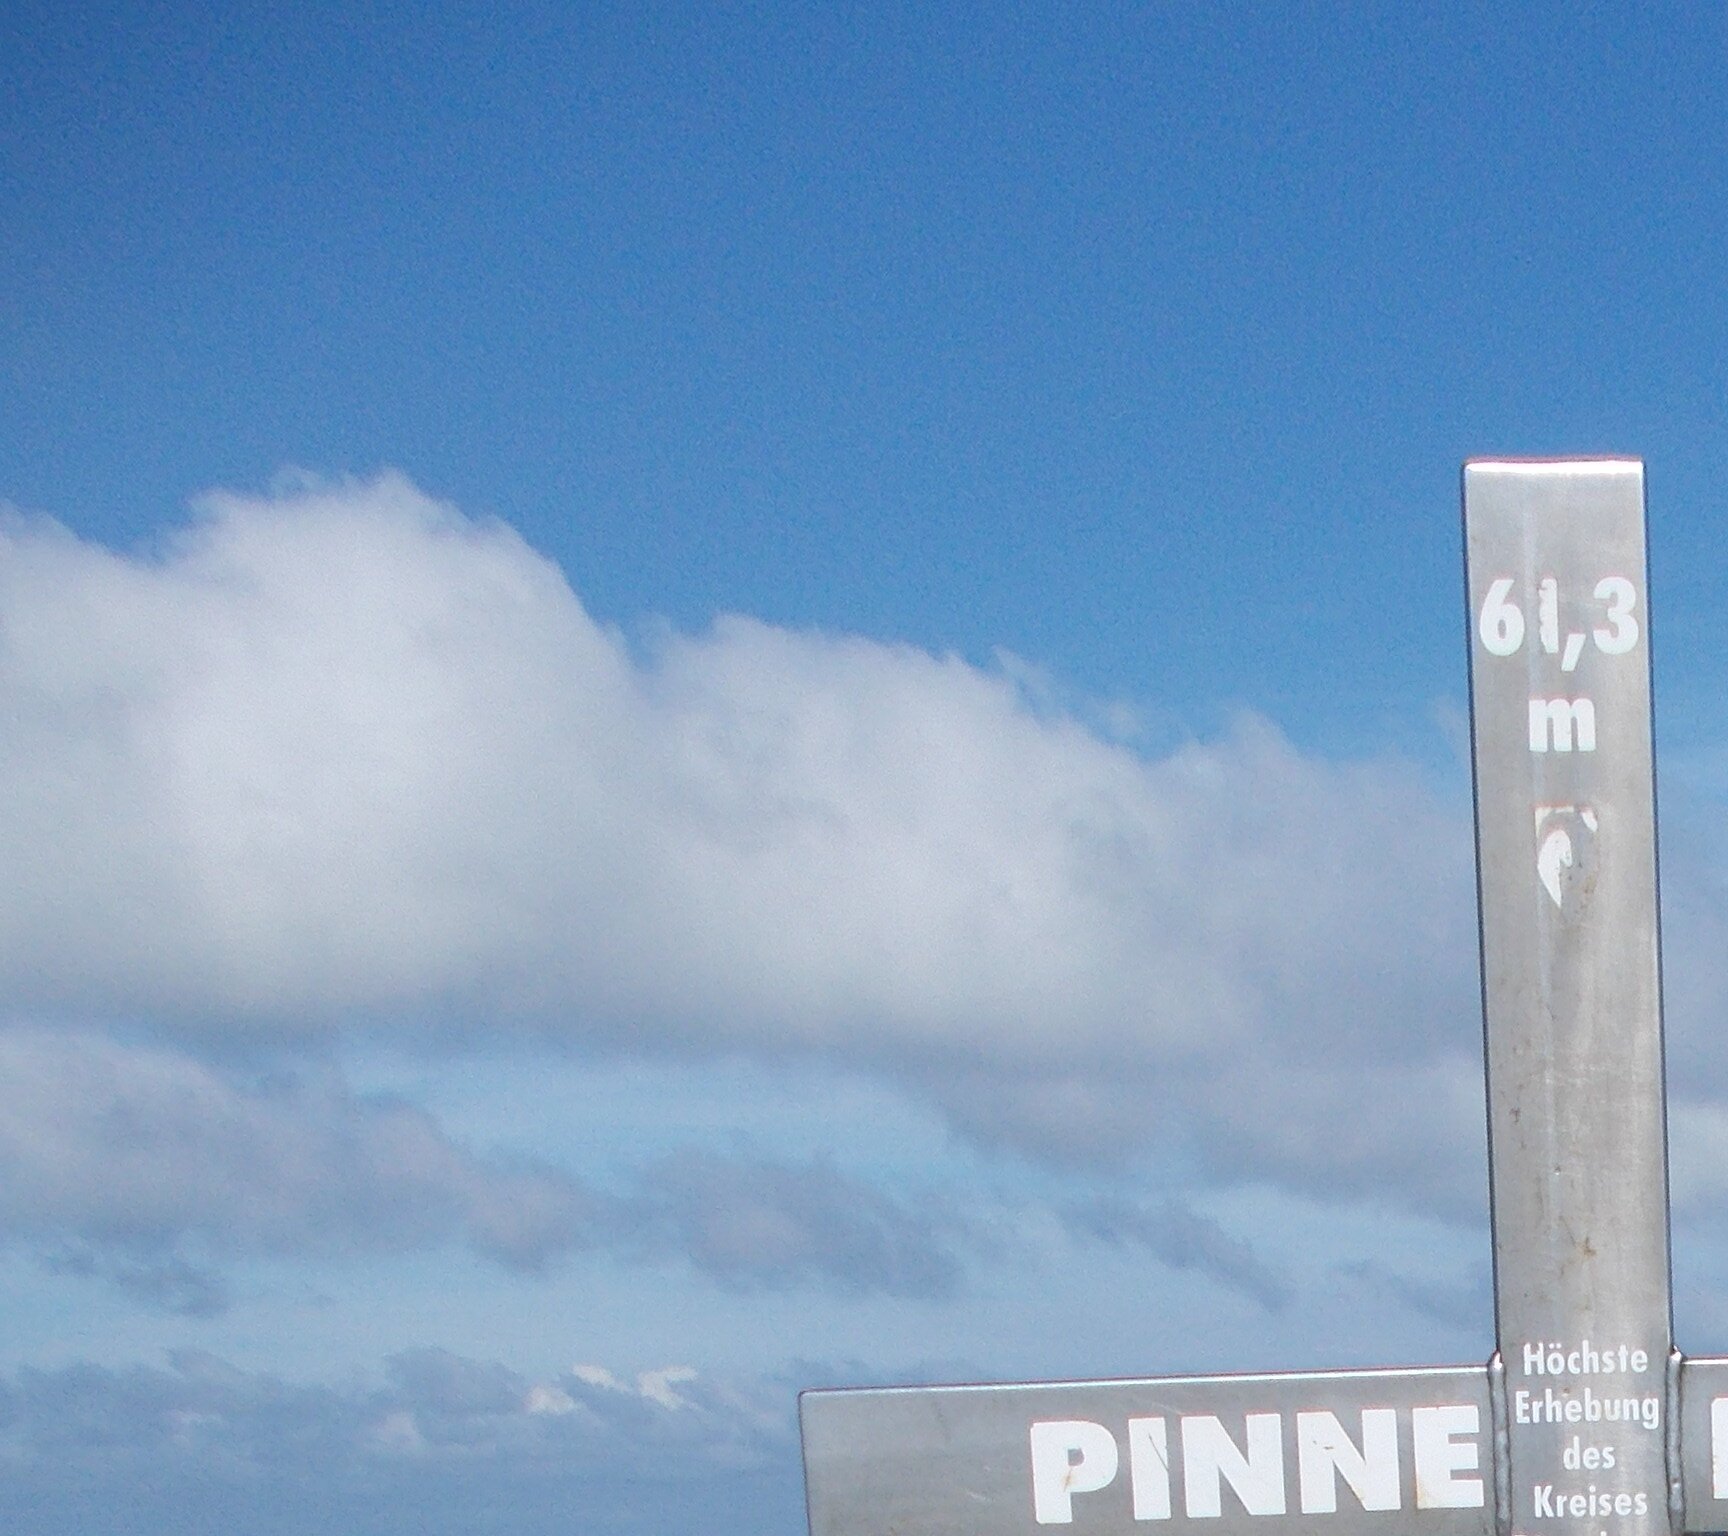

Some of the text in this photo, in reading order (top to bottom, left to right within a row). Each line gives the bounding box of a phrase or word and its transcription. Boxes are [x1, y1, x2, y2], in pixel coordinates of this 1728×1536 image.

[1479, 576, 1639, 671] 61,3
[1529, 697, 1596, 752] m
[1523, 1340, 1648, 1376] Höchste
[1515, 1388, 1659, 1430] Erhebung
[1030, 1405, 1485, 1524] PINNE
[1563, 1435, 1616, 1470] des
[1534, 1485, 1648, 1518] Kreises
